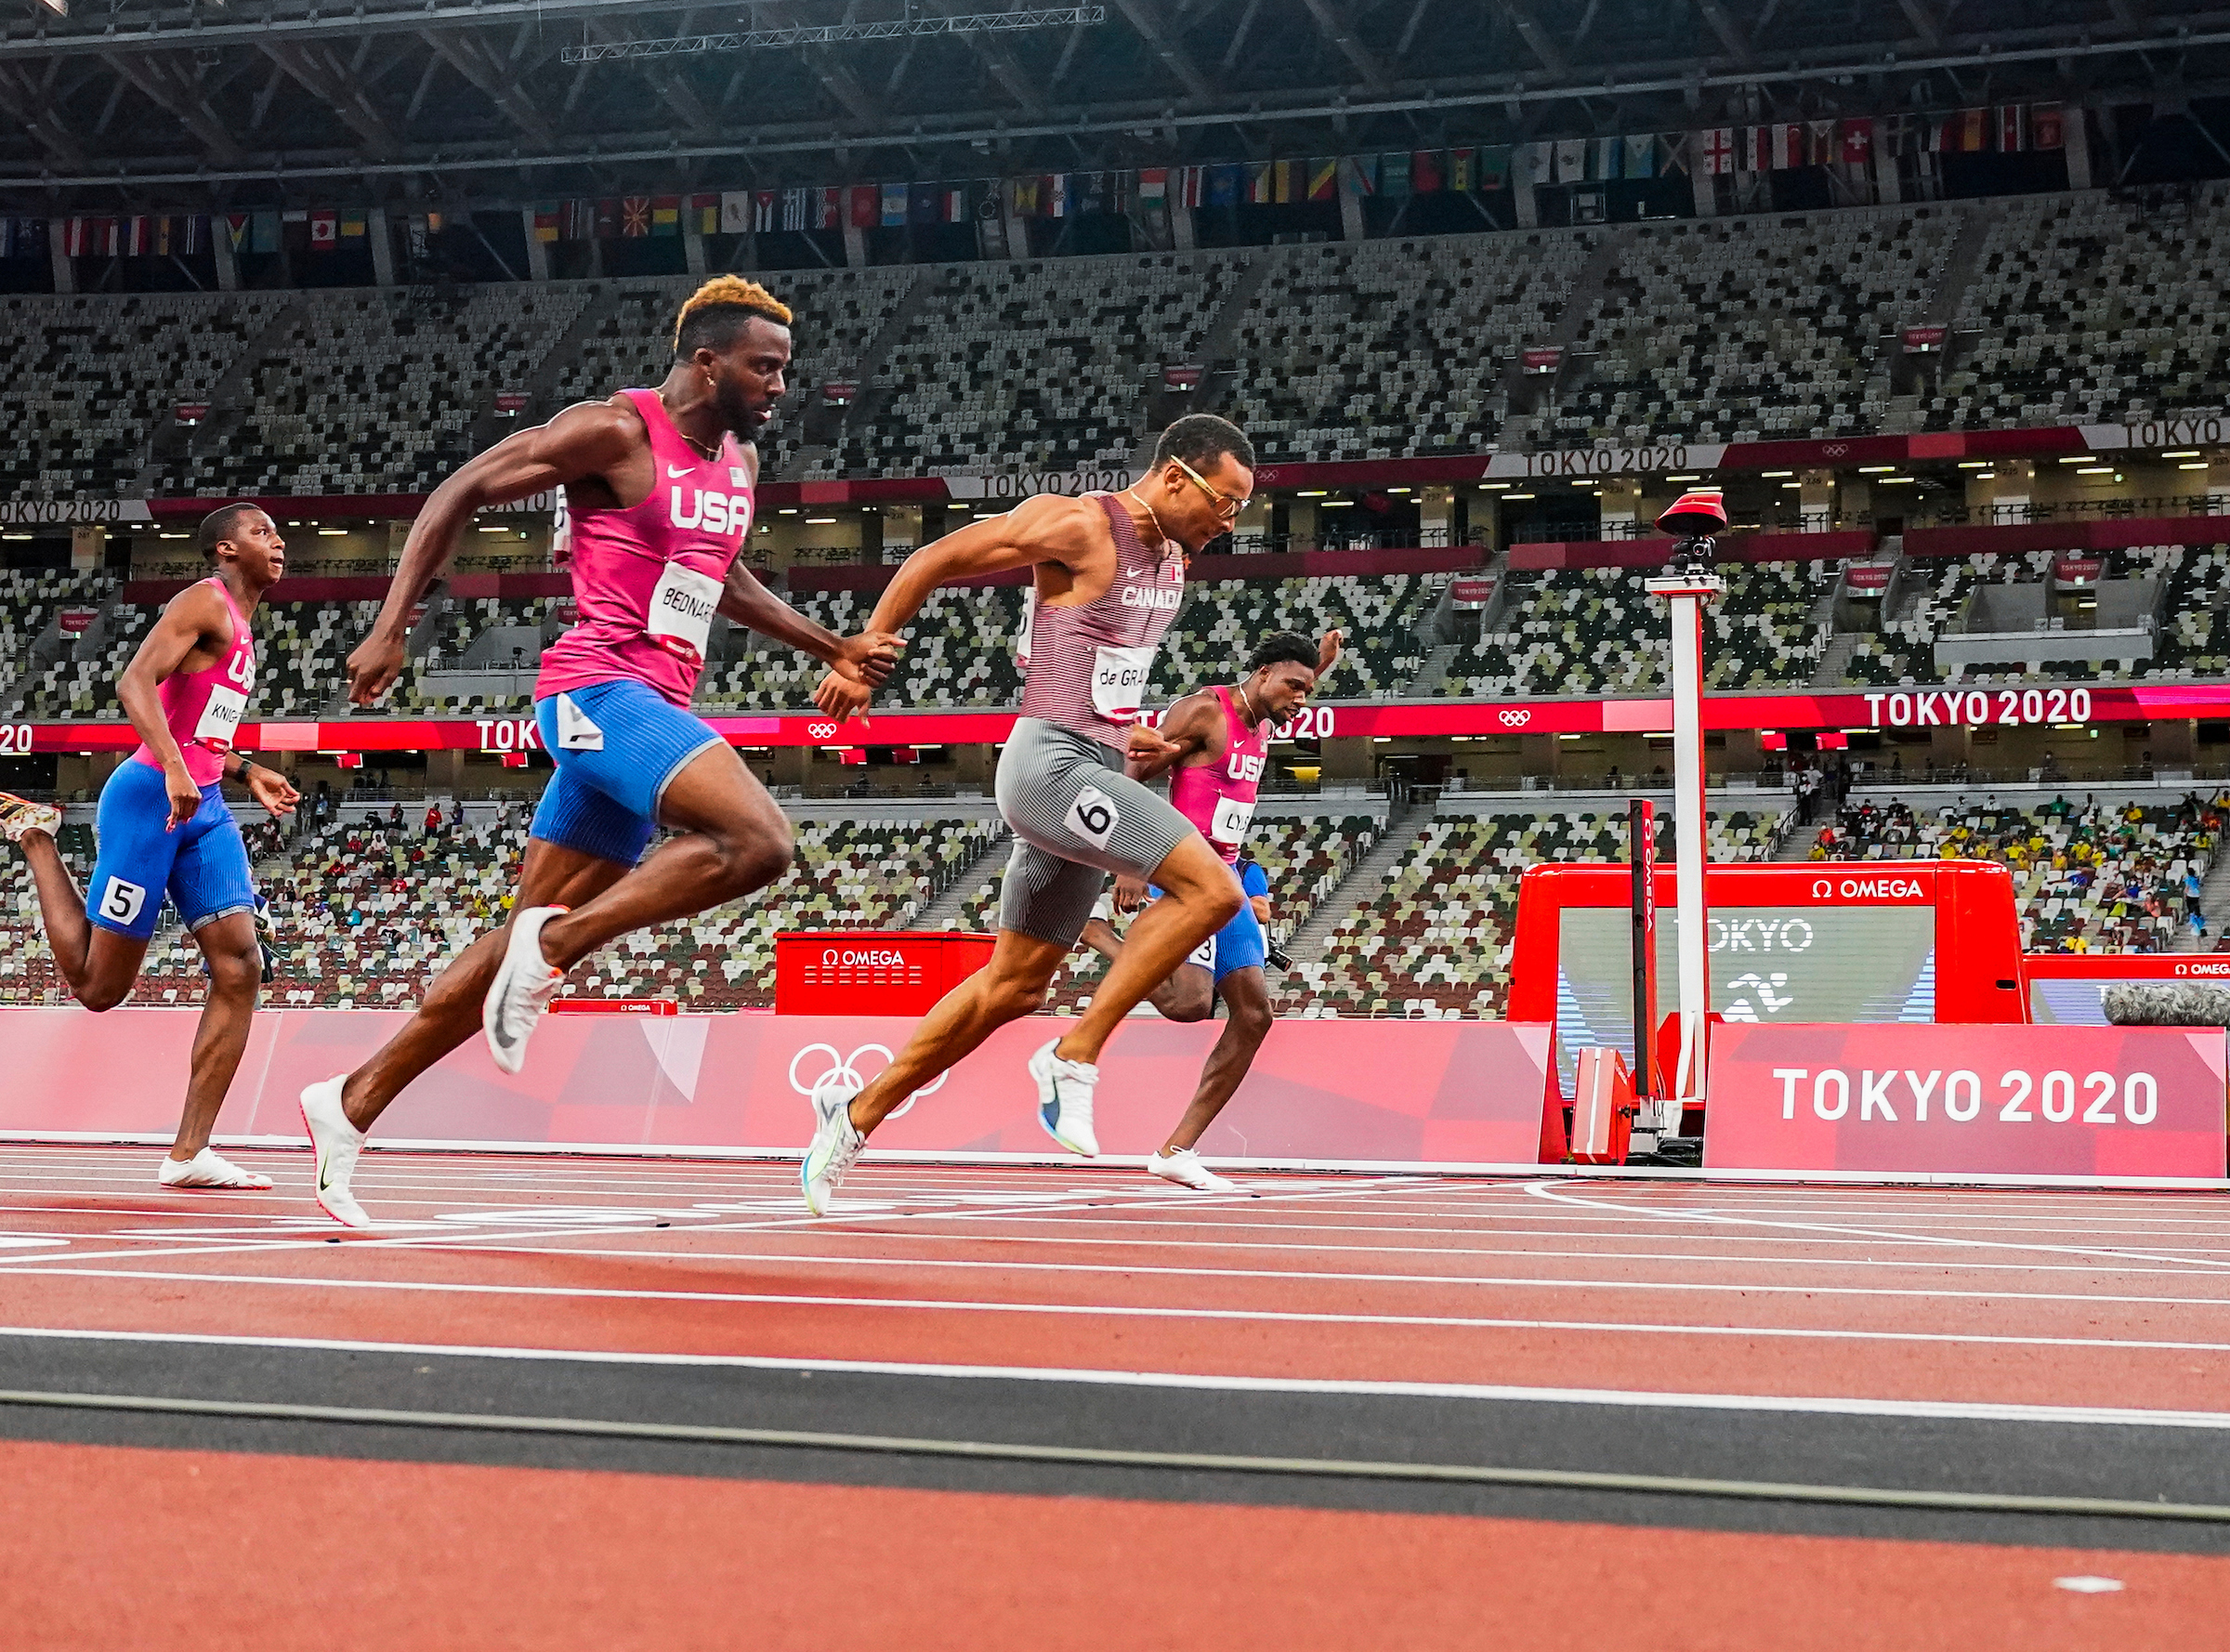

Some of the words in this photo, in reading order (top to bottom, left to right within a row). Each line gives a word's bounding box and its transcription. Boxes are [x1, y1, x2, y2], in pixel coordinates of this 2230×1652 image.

[2121, 418, 2221, 448] TOKYO
[1522, 449, 1612, 477] TOKYO
[1620, 446, 1686, 471] 2020
[979, 472, 1062, 499] TOKYO
[1069, 468, 1130, 495] 2020
[66, 499, 120, 521] 2020
[670, 485, 751, 537] USA
[1099, 668, 1117, 686] de
[1864, 691, 1988, 727] TOKYO
[1998, 688, 2092, 725] 2020
[476, 719, 538, 750] TOK
[1076, 804, 1110, 835] 6
[109, 883, 134, 918] 5
[1645, 847, 1654, 933] OMEGA
[1840, 879, 1924, 898] OMEGA
[1673, 918, 1814, 952] OKYO
[842, 950, 905, 965] OMEGA
[2190, 964, 2230, 976] OMEG
[1772, 1068, 1981, 1122] TOKYO
[1999, 1069, 2158, 1125] 2020
